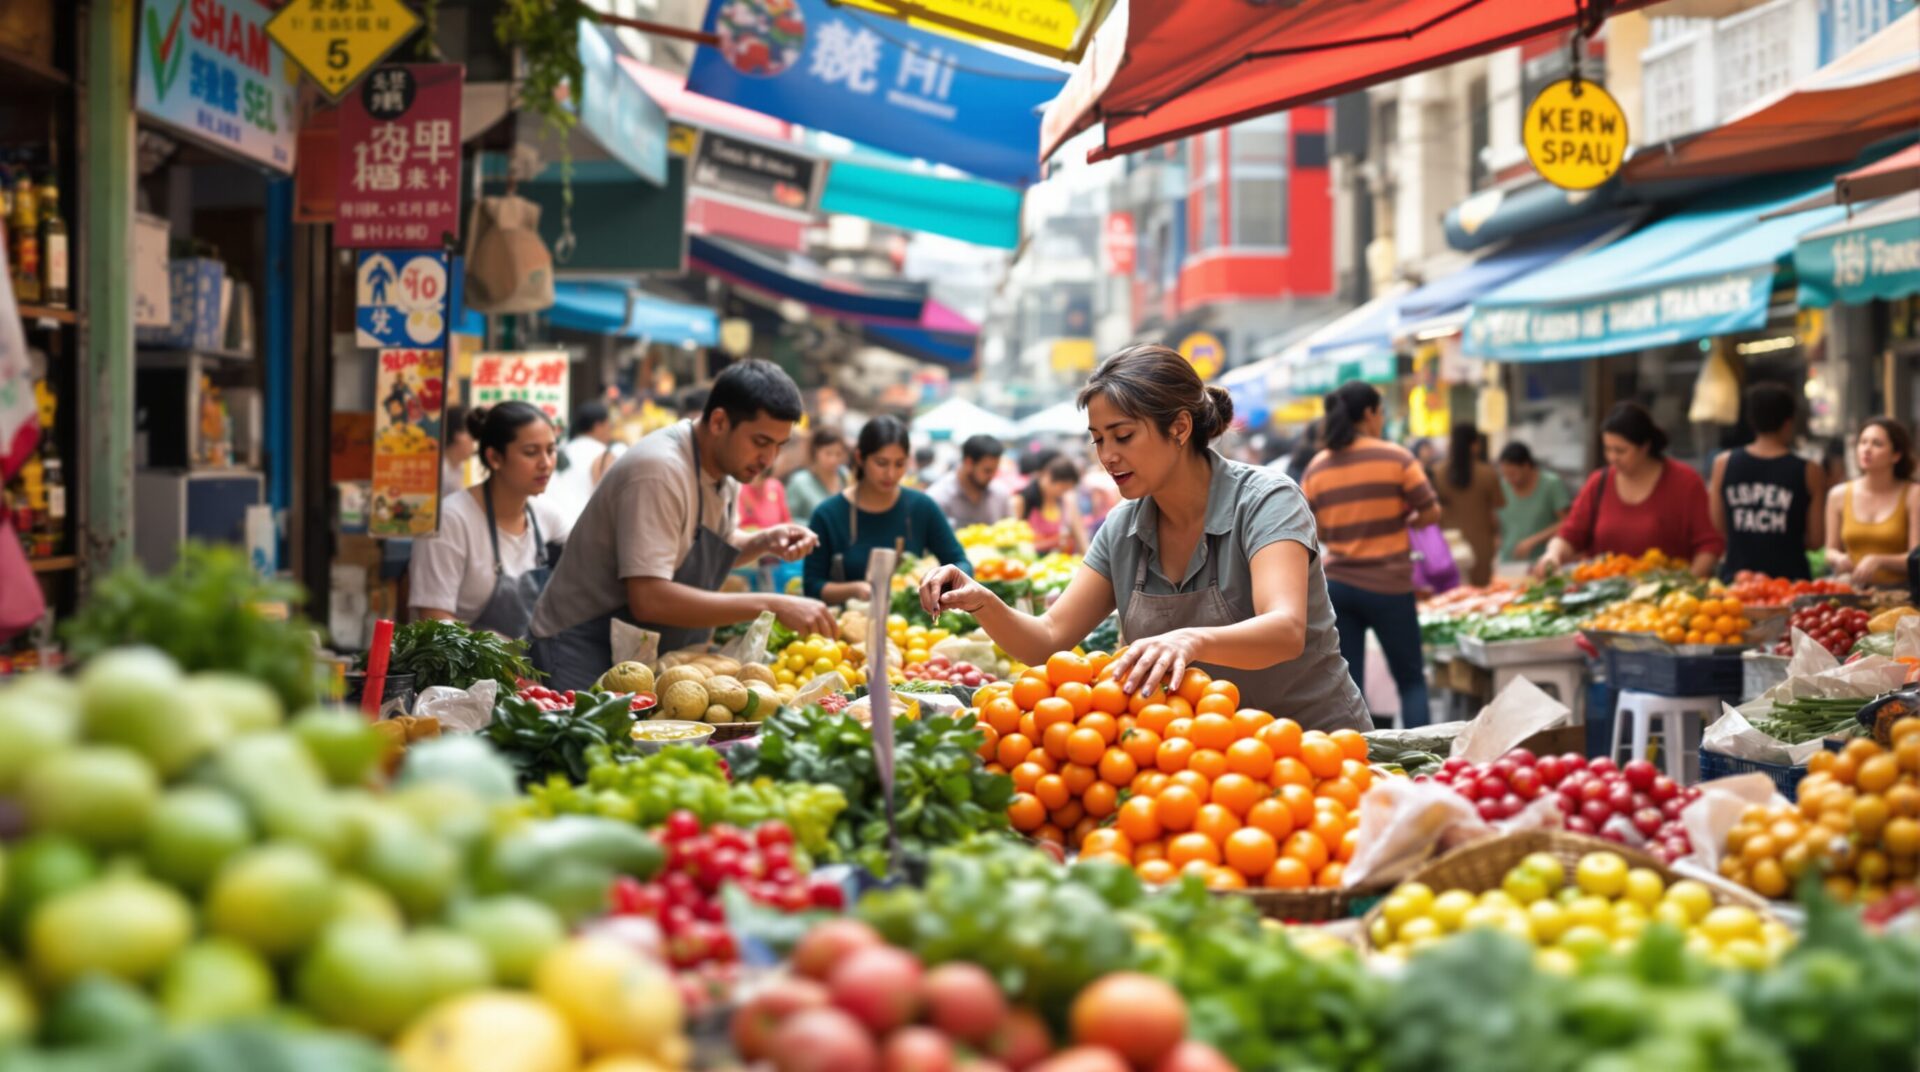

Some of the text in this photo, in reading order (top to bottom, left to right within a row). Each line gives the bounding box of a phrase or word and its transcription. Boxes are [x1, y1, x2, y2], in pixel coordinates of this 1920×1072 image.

[189, 0, 270, 77] SHAM
[327, 38, 350, 70] 5
[1539, 107, 1616, 136] KERW
[1541, 140, 1612, 166] SPAU
[1733, 508, 1787, 533] FACH
